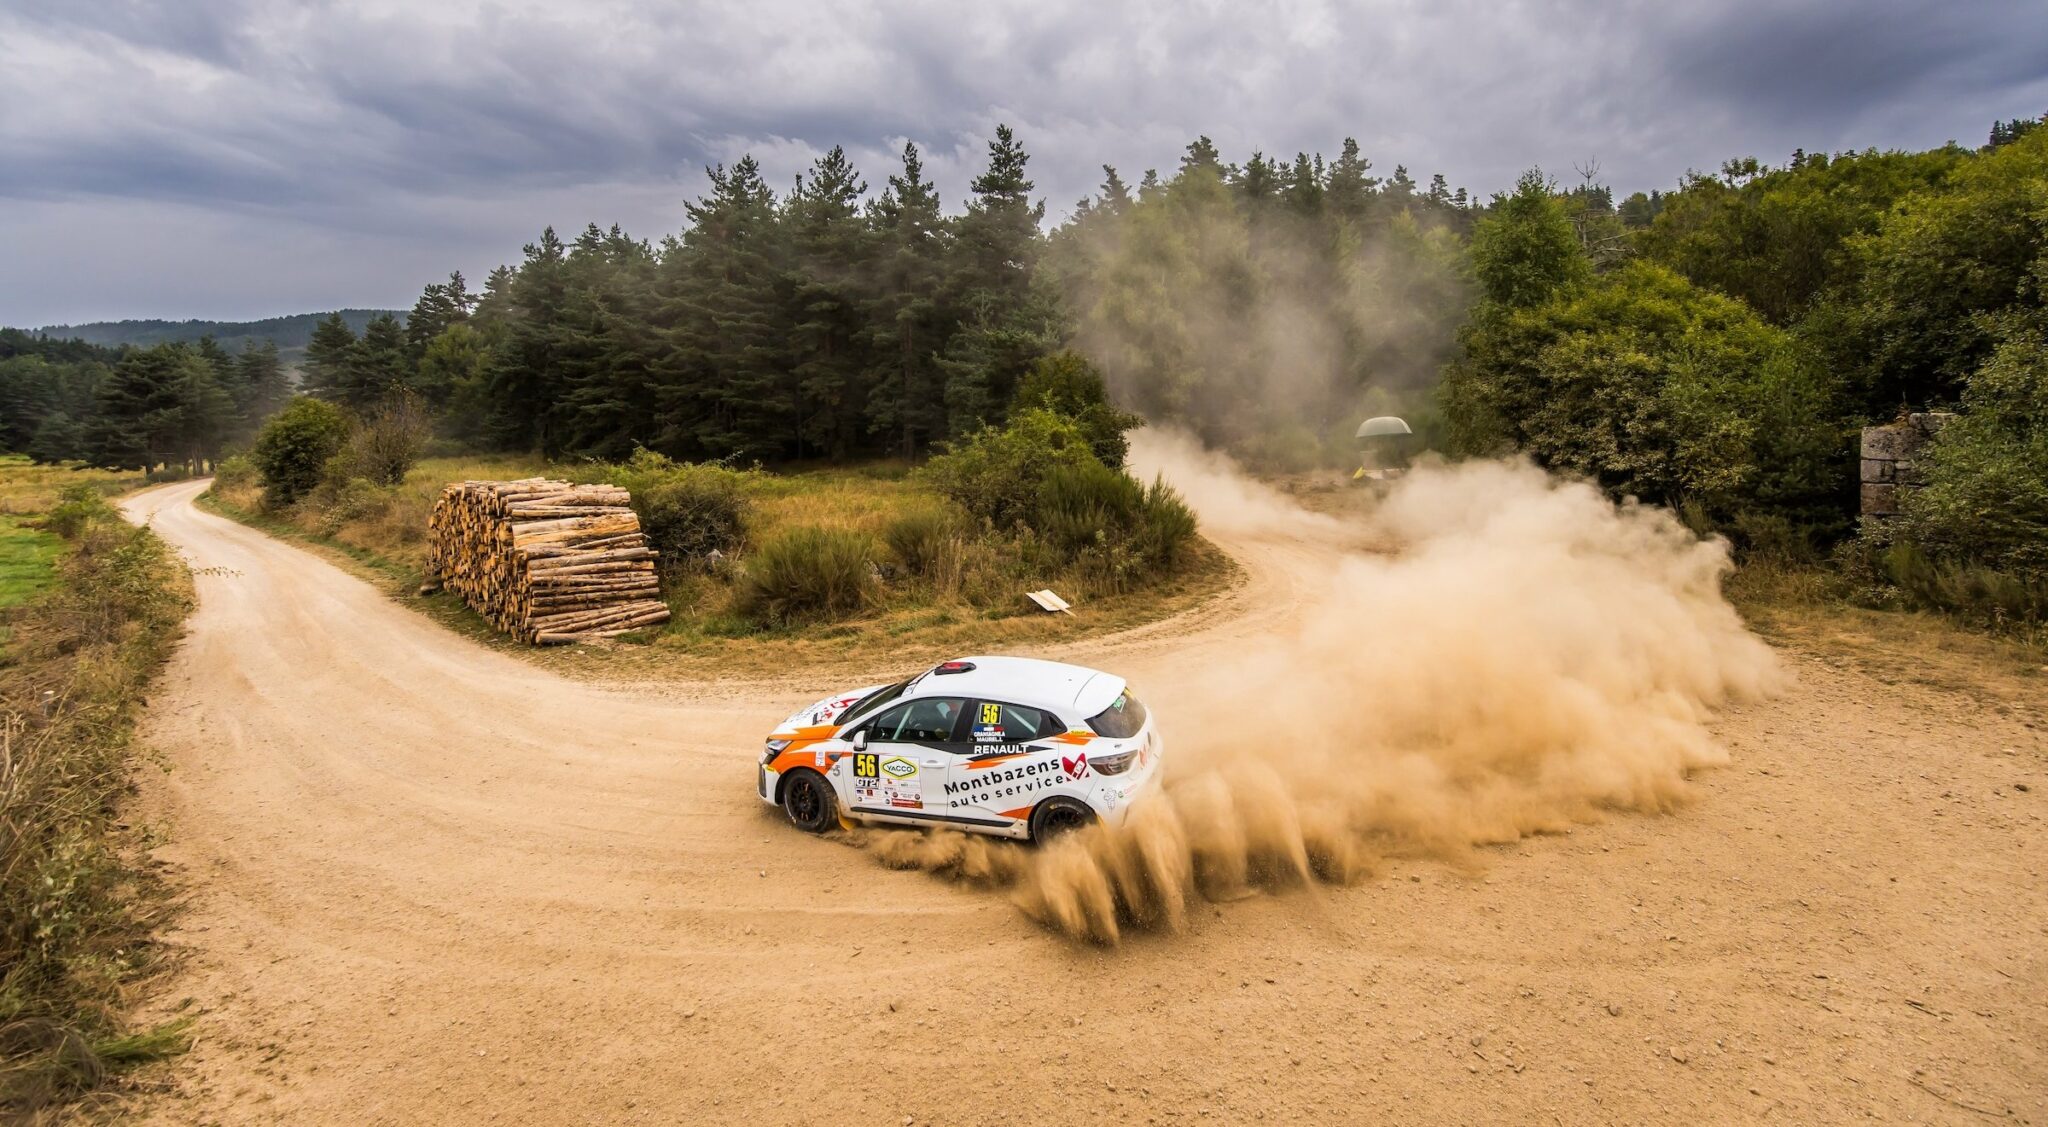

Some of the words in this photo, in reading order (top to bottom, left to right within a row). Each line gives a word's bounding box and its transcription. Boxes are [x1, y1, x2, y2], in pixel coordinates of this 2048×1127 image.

[983, 704, 998, 724] 56
[974, 745, 1029, 754] RENAULT
[857, 754, 876, 776] 56
[887, 765, 913, 773] YACCO
[944, 758, 1060, 795] Montbazens
[951, 793, 989, 808] auto
[995, 775, 1063, 798] service
